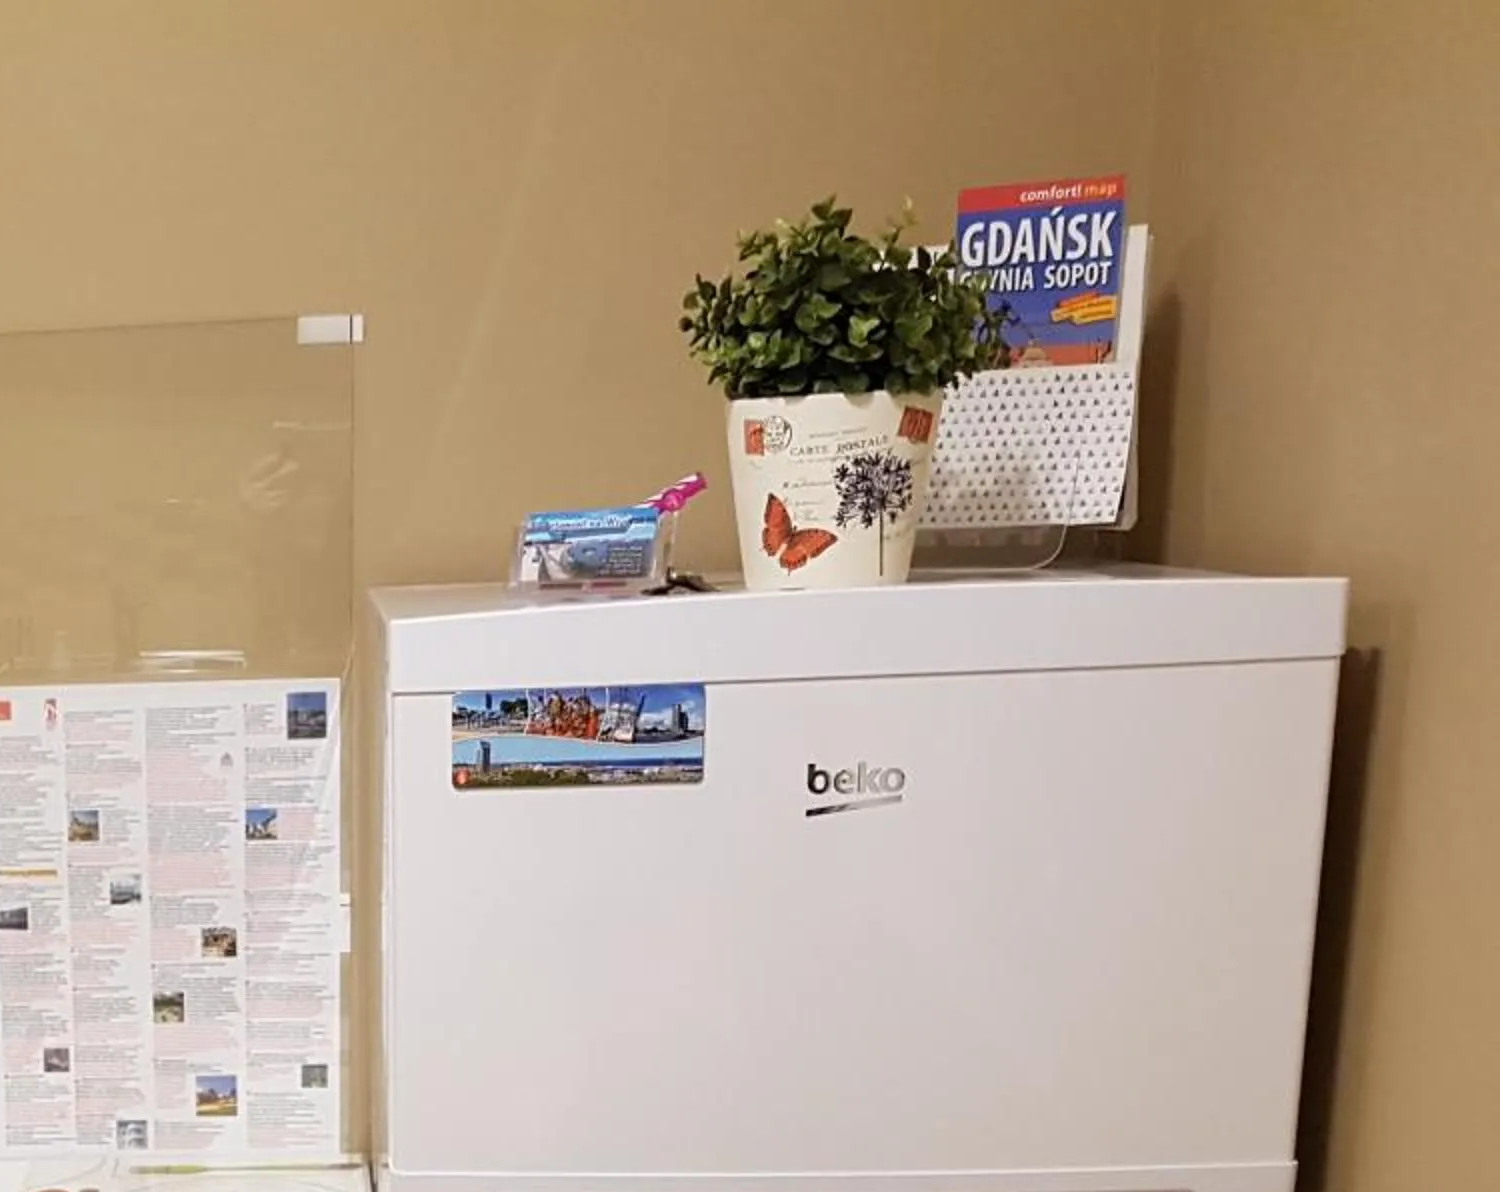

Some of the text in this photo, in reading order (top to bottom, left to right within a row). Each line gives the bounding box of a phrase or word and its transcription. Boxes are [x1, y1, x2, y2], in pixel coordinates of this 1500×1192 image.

[1084, 182, 1117, 201] map
[961, 205, 1117, 268] GDAŃSK
[1043, 261, 1112, 289] SOPOT
[806, 761, 906, 795] beko
